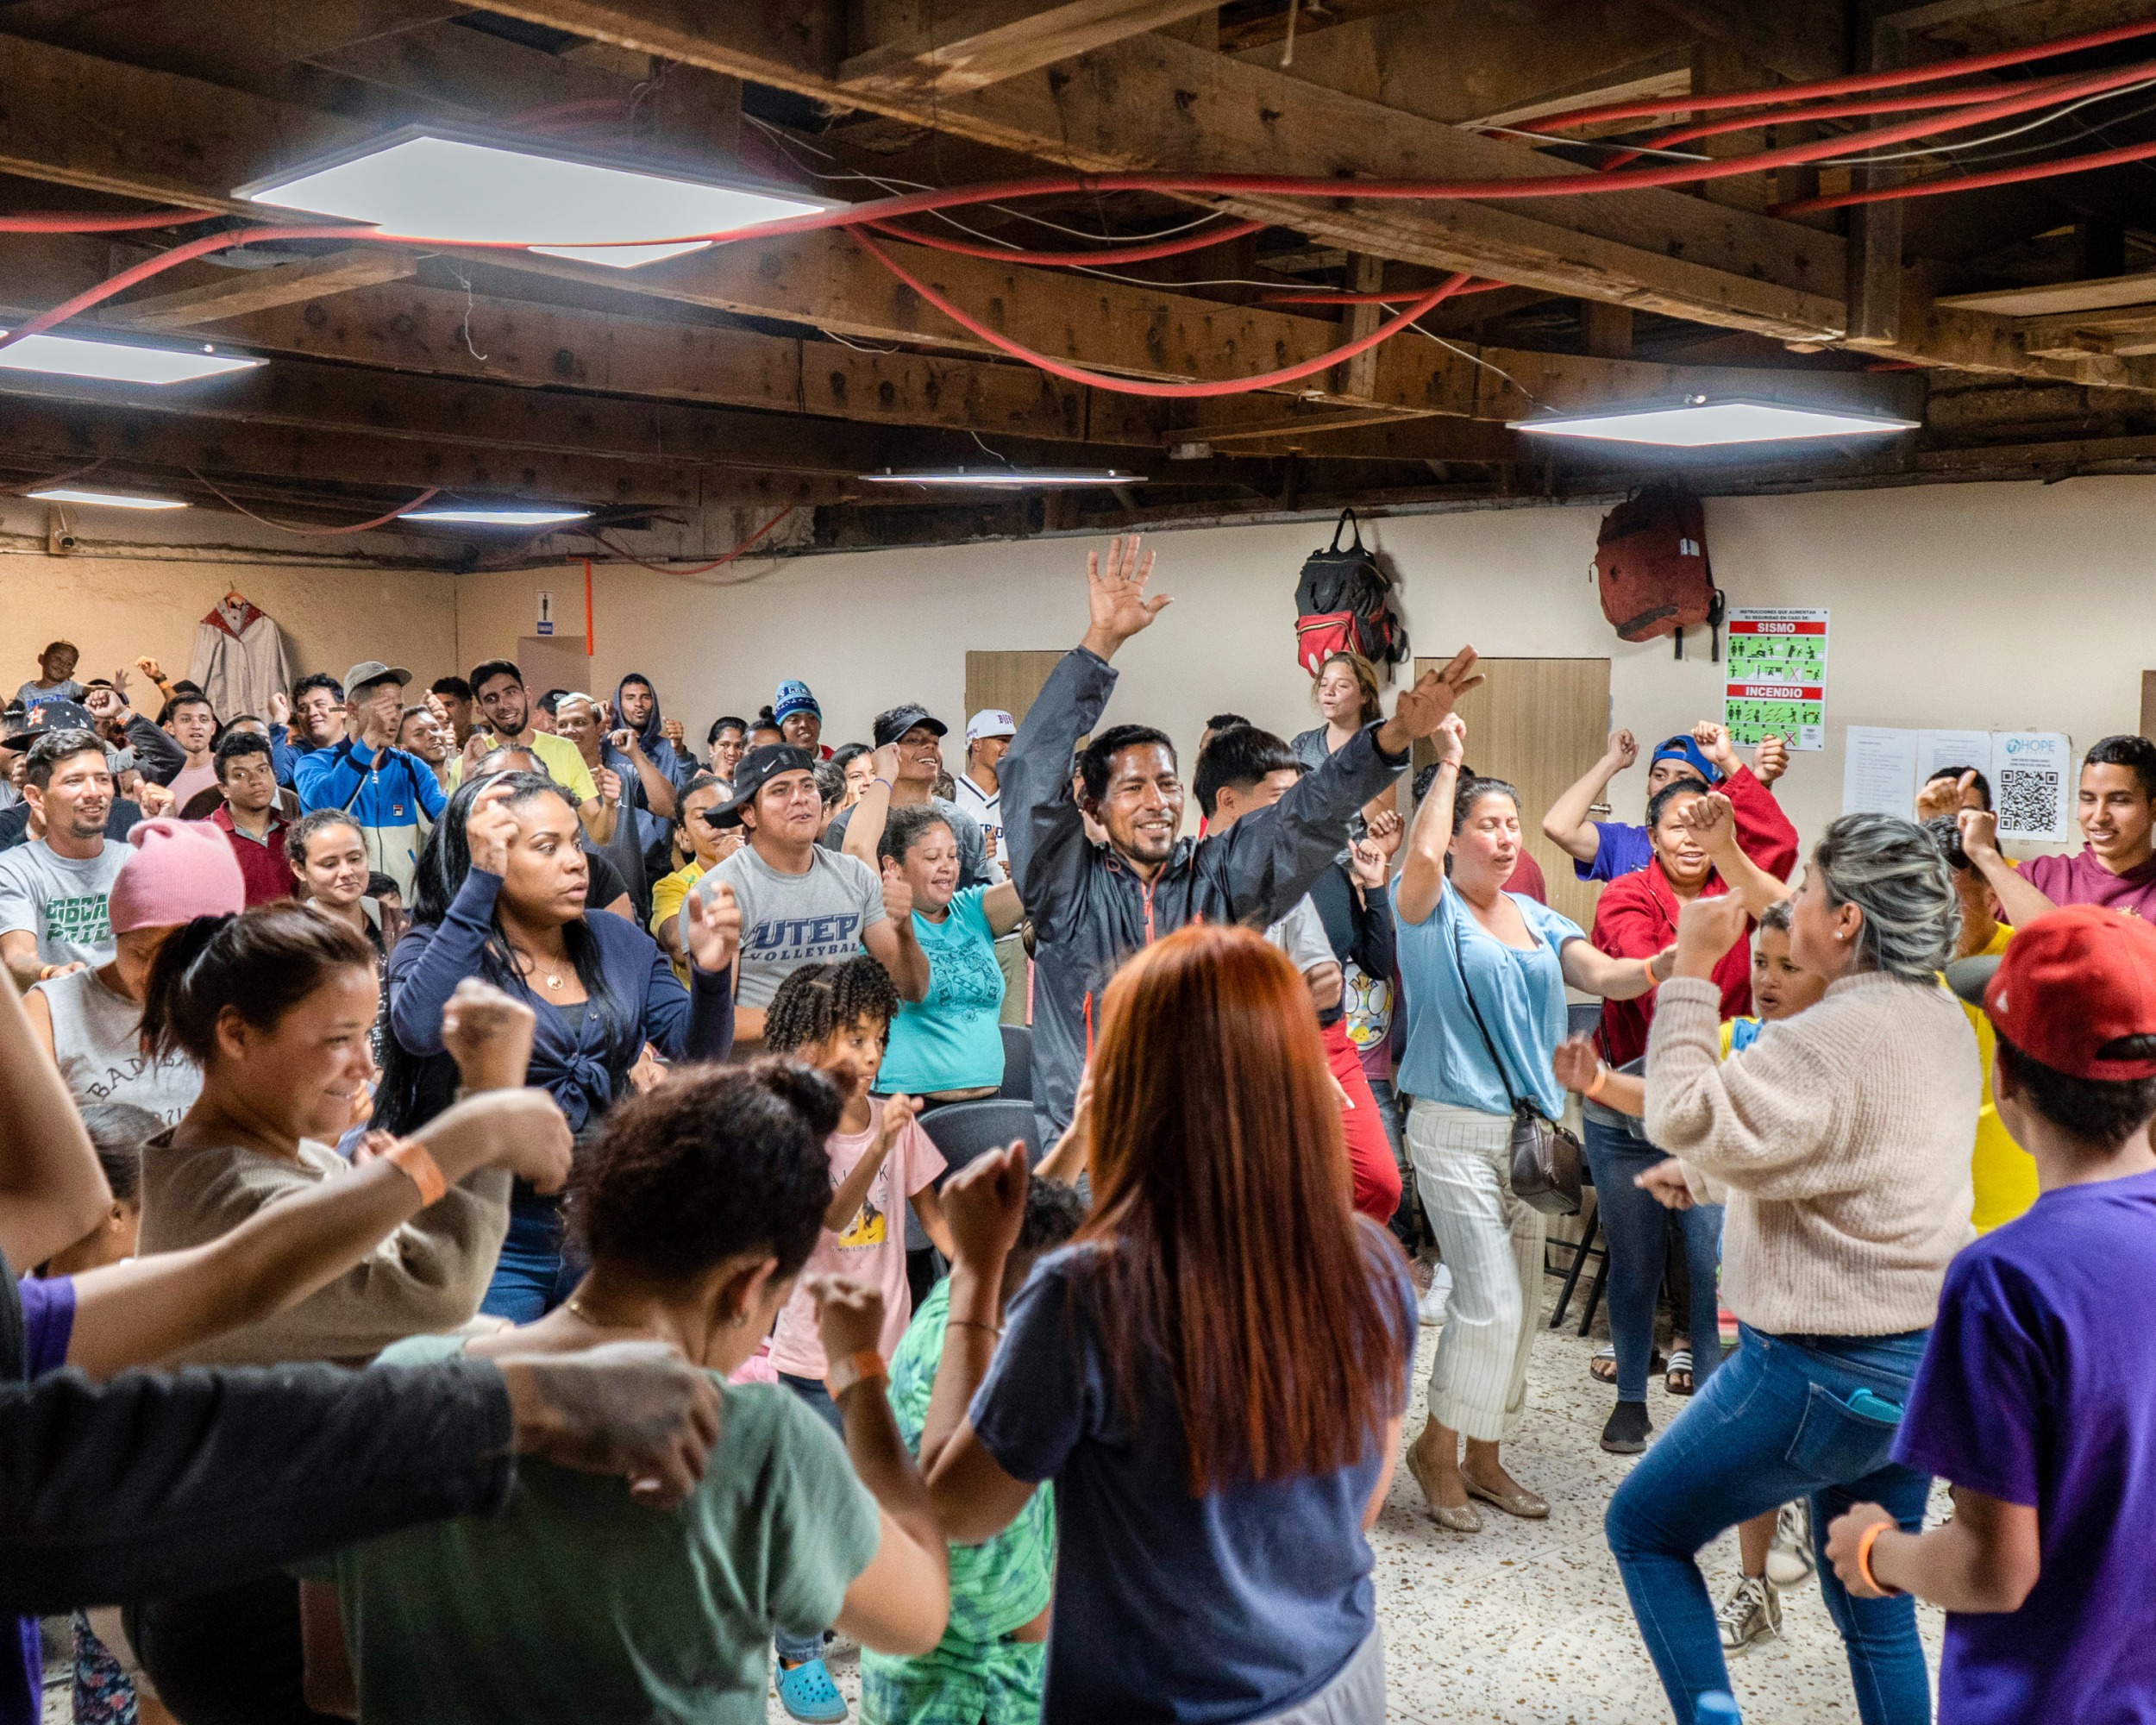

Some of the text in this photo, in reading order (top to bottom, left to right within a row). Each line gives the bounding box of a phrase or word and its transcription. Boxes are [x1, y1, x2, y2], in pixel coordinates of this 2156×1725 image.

[1757, 623, 1796, 633] SISMO
[1745, 687, 1802, 698] INCENDIO
[2021, 739, 2055, 751] HOPE
[752, 913, 860, 950] UTEP
[749, 942, 858, 962] VOLLEYBAL
